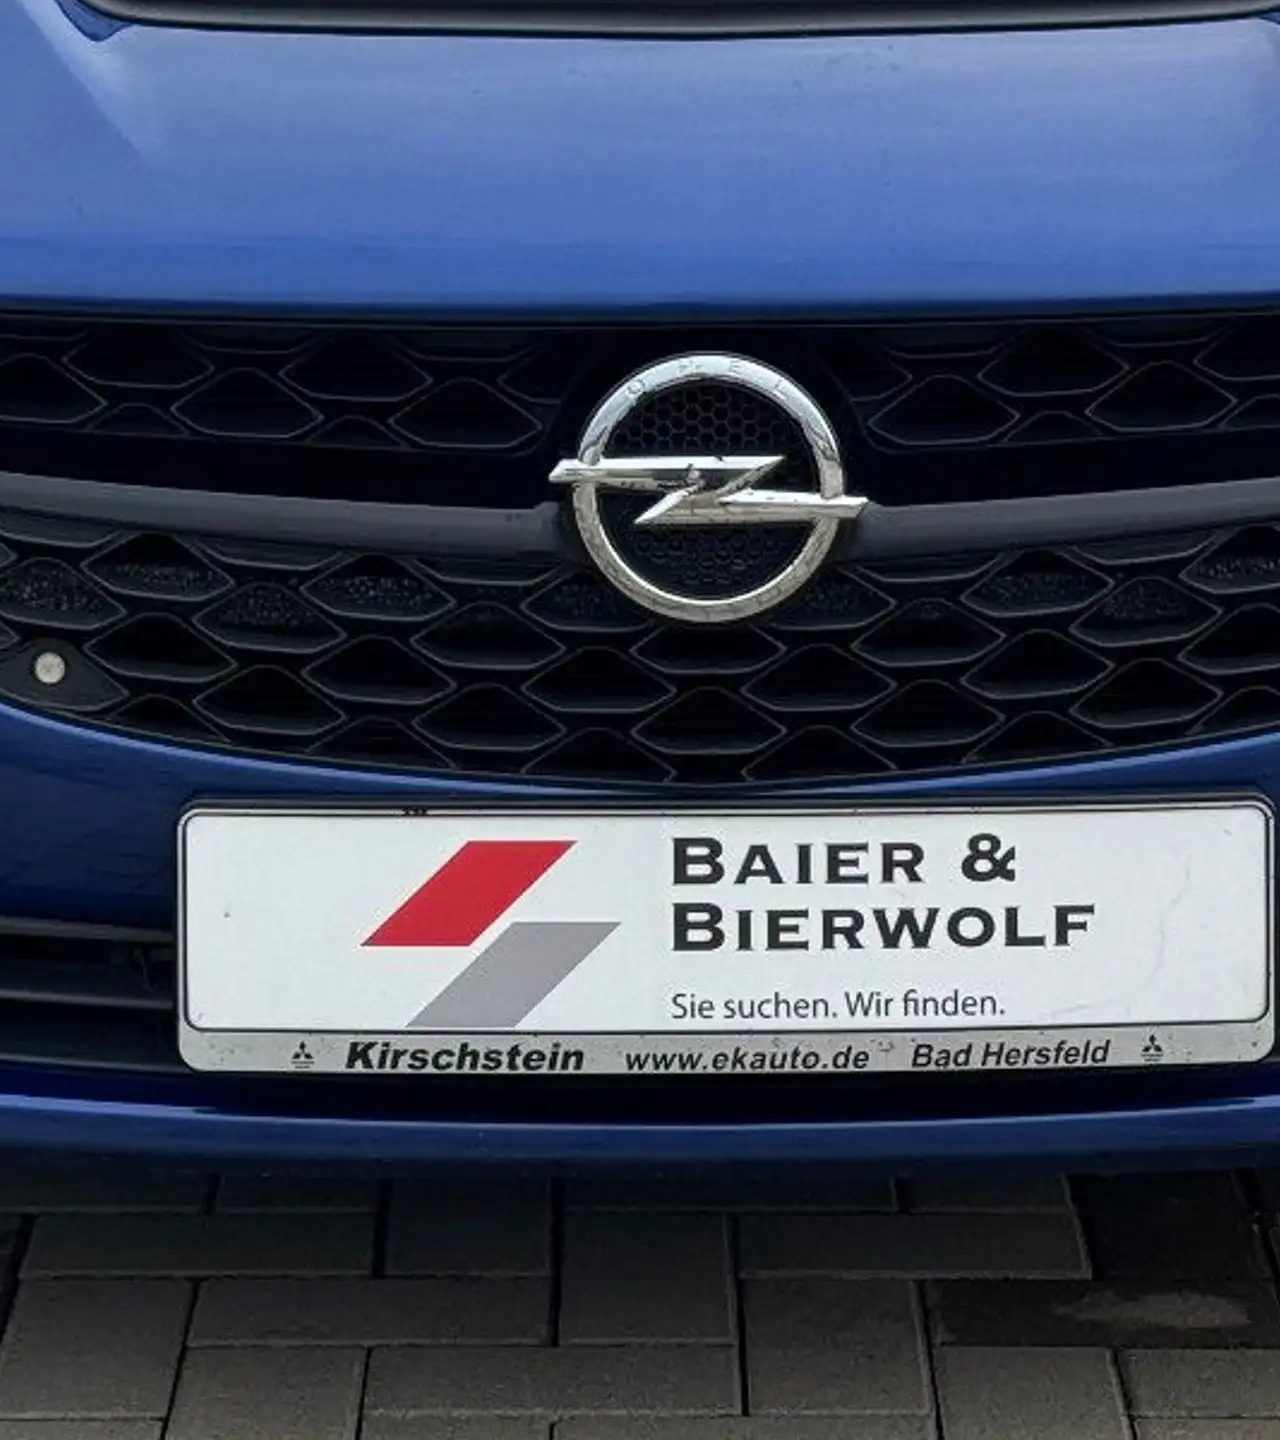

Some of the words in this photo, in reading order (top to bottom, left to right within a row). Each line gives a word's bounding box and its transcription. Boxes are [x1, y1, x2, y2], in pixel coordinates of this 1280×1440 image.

[672, 836, 926, 886] BAIER
[960, 832, 1017, 882] &
[672, 902, 1096, 952] BIERWOLF
[671, 992, 715, 1020] Sie
[723, 991, 838, 1020] suchen.
[844, 991, 894, 1019] Wir
[902, 988, 1006, 1017] finden.
[345, 1041, 585, 1072] Kirschstein
[624, 1045, 870, 1071] www.ekauto.de
[911, 1043, 973, 1069] Bad
[980, 1039, 1112, 1067] Hersfeld
